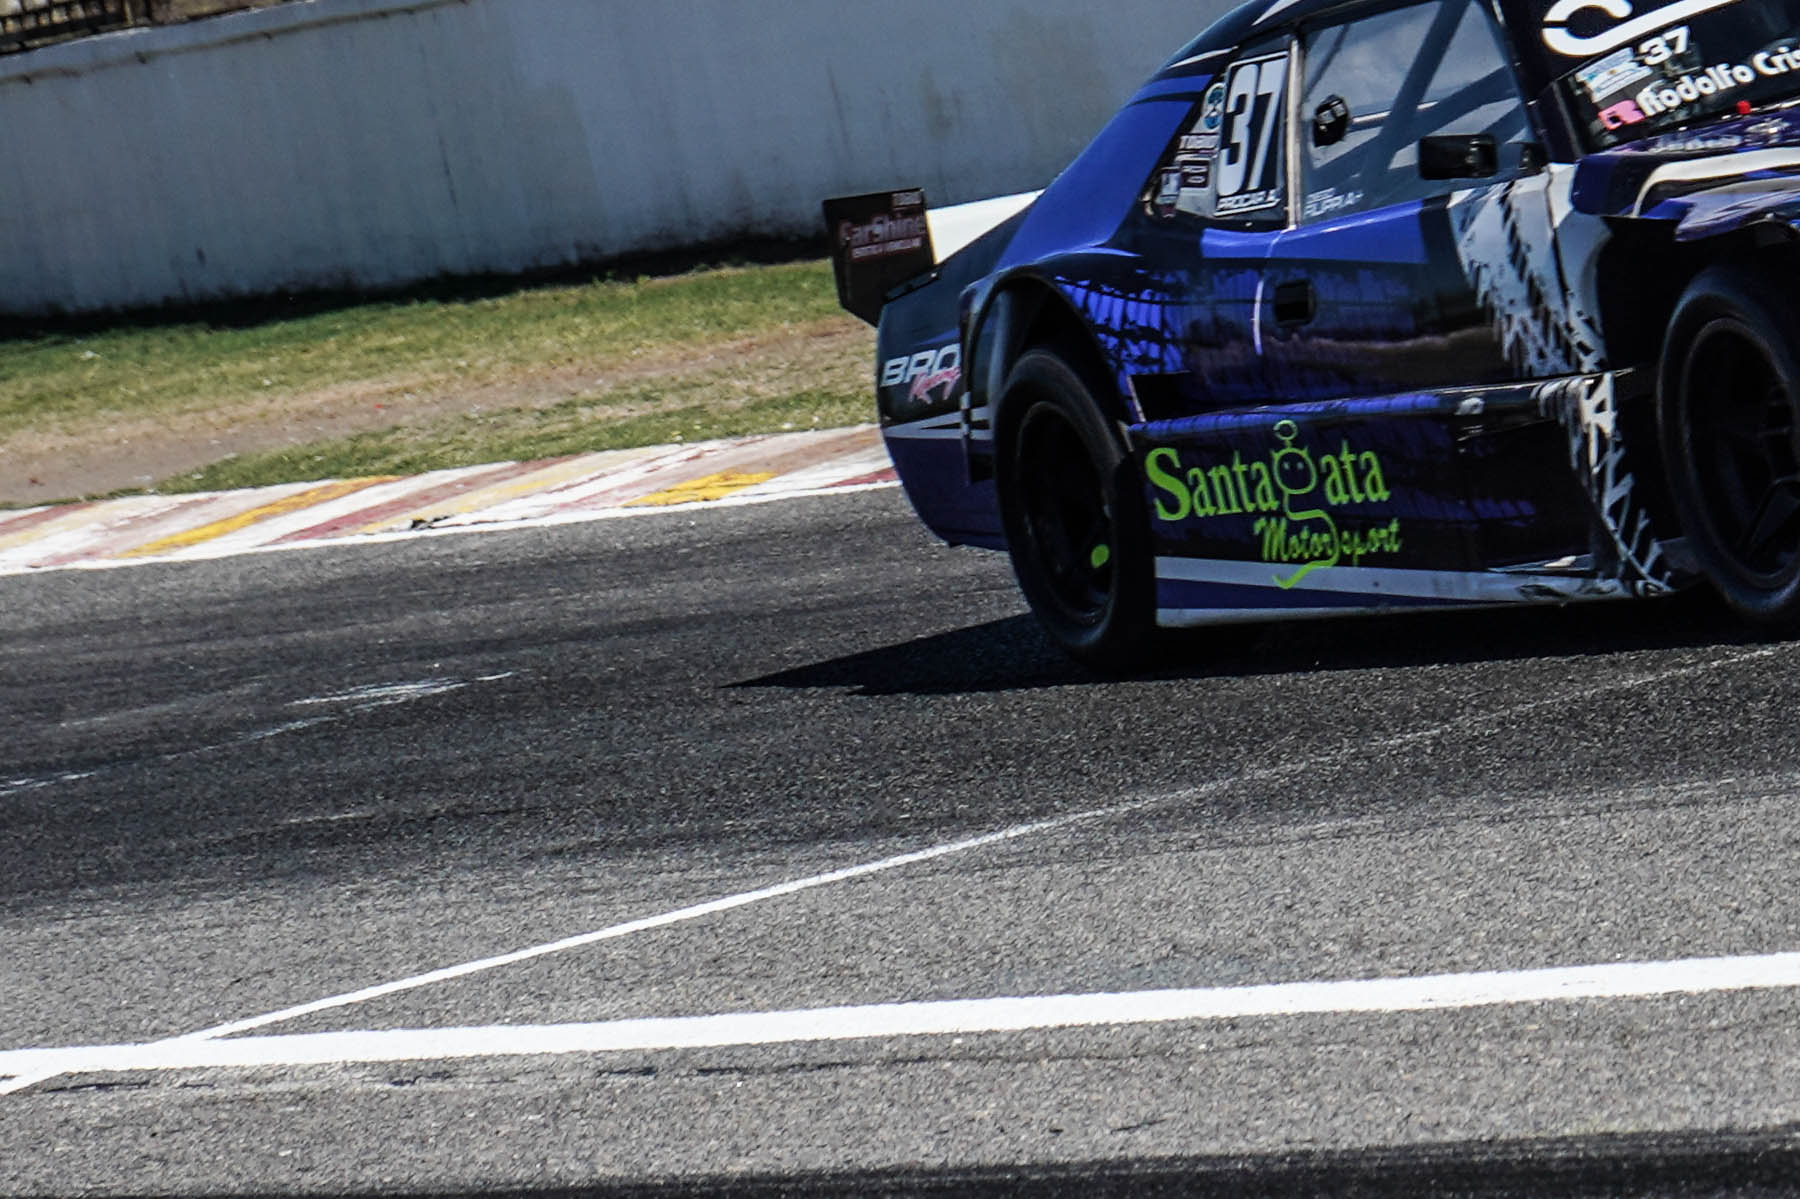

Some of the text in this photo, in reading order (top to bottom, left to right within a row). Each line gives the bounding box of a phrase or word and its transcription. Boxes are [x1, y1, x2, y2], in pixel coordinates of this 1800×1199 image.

[1639, 25, 1690, 66] 37
[1636, 62, 1756, 118] Rodolfo
[1216, 57, 1288, 197] 37
